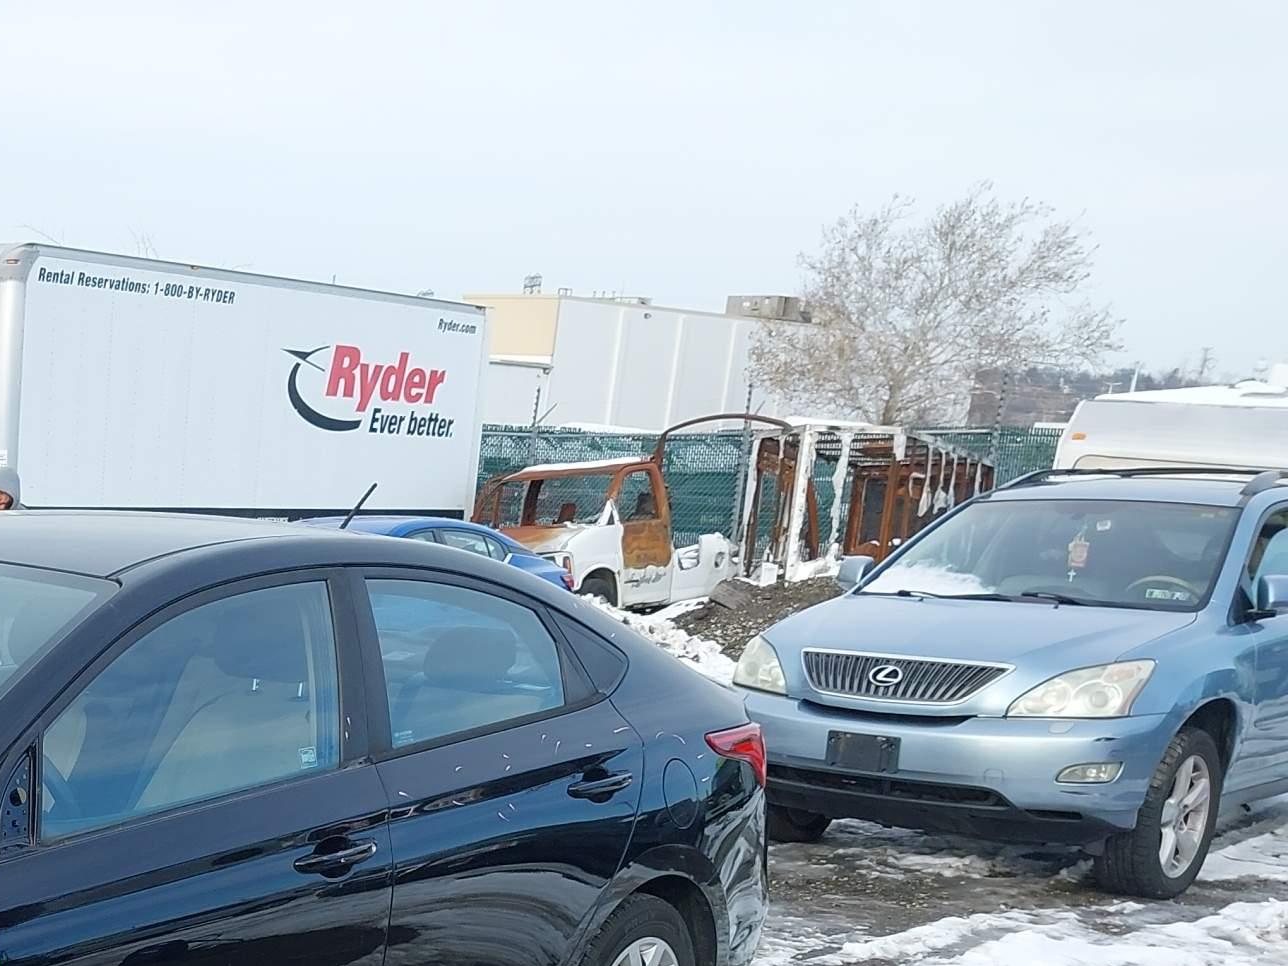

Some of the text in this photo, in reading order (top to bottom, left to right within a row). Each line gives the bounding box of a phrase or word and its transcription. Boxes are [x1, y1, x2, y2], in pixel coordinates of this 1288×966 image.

[38, 267, 236, 304] Rental Reservations: 1-800-BY-RYDER
[437, 318, 477, 334] Ryder.com
[325, 344, 447, 412] Ryder
[369, 408, 454, 438] Ever better.
